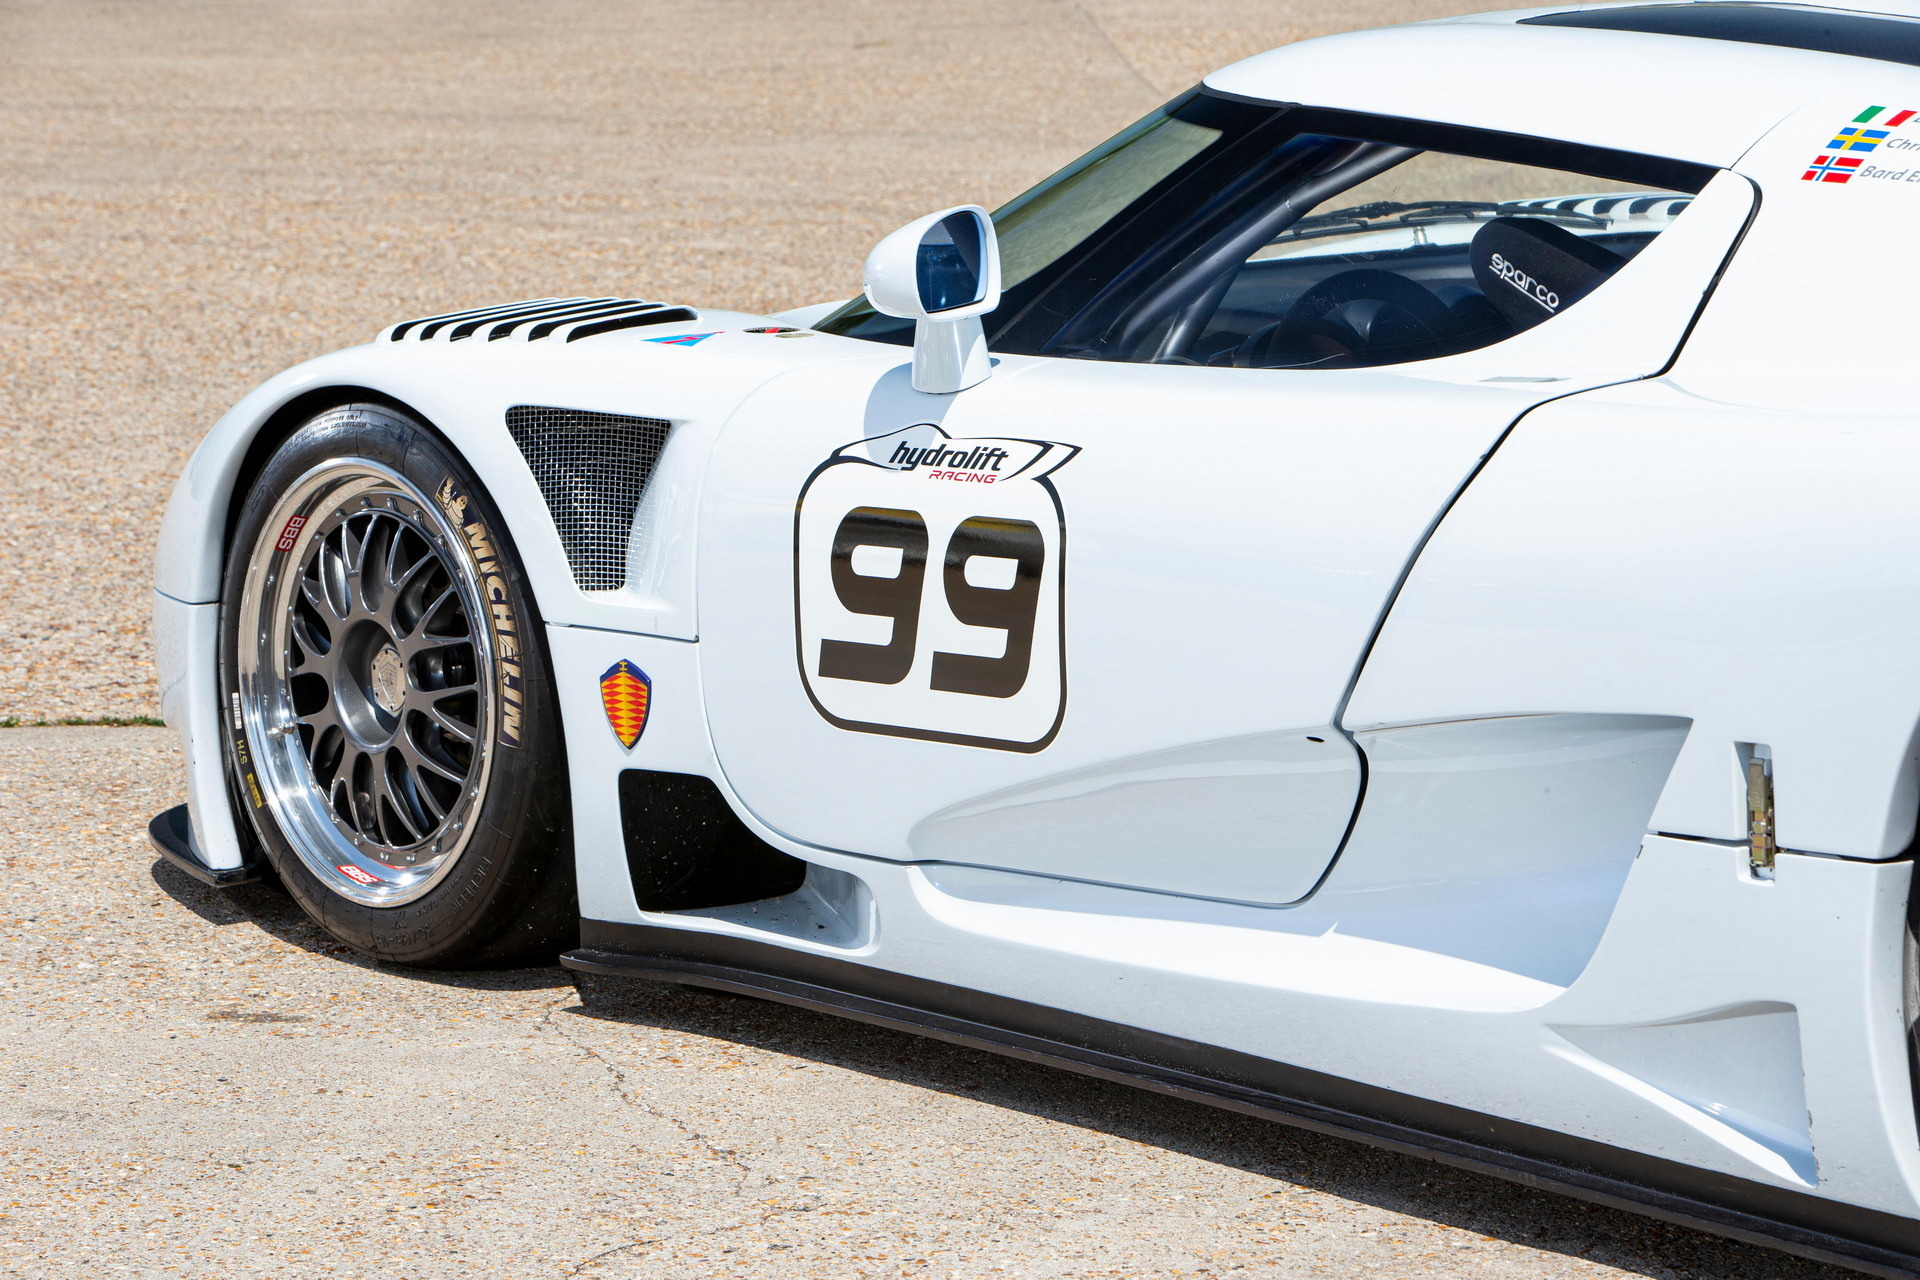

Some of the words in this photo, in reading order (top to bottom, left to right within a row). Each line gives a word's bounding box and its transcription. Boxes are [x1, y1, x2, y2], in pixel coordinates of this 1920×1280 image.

[1859, 165, 1908, 181] Bard
[1491, 253, 1559, 309] sparco
[888, 441, 1010, 472] hydrolift
[928, 470, 998, 484] RACING
[278, 516, 306, 550] BBS
[817, 505, 1046, 699] 99
[463, 521, 523, 742] MICHELIN
